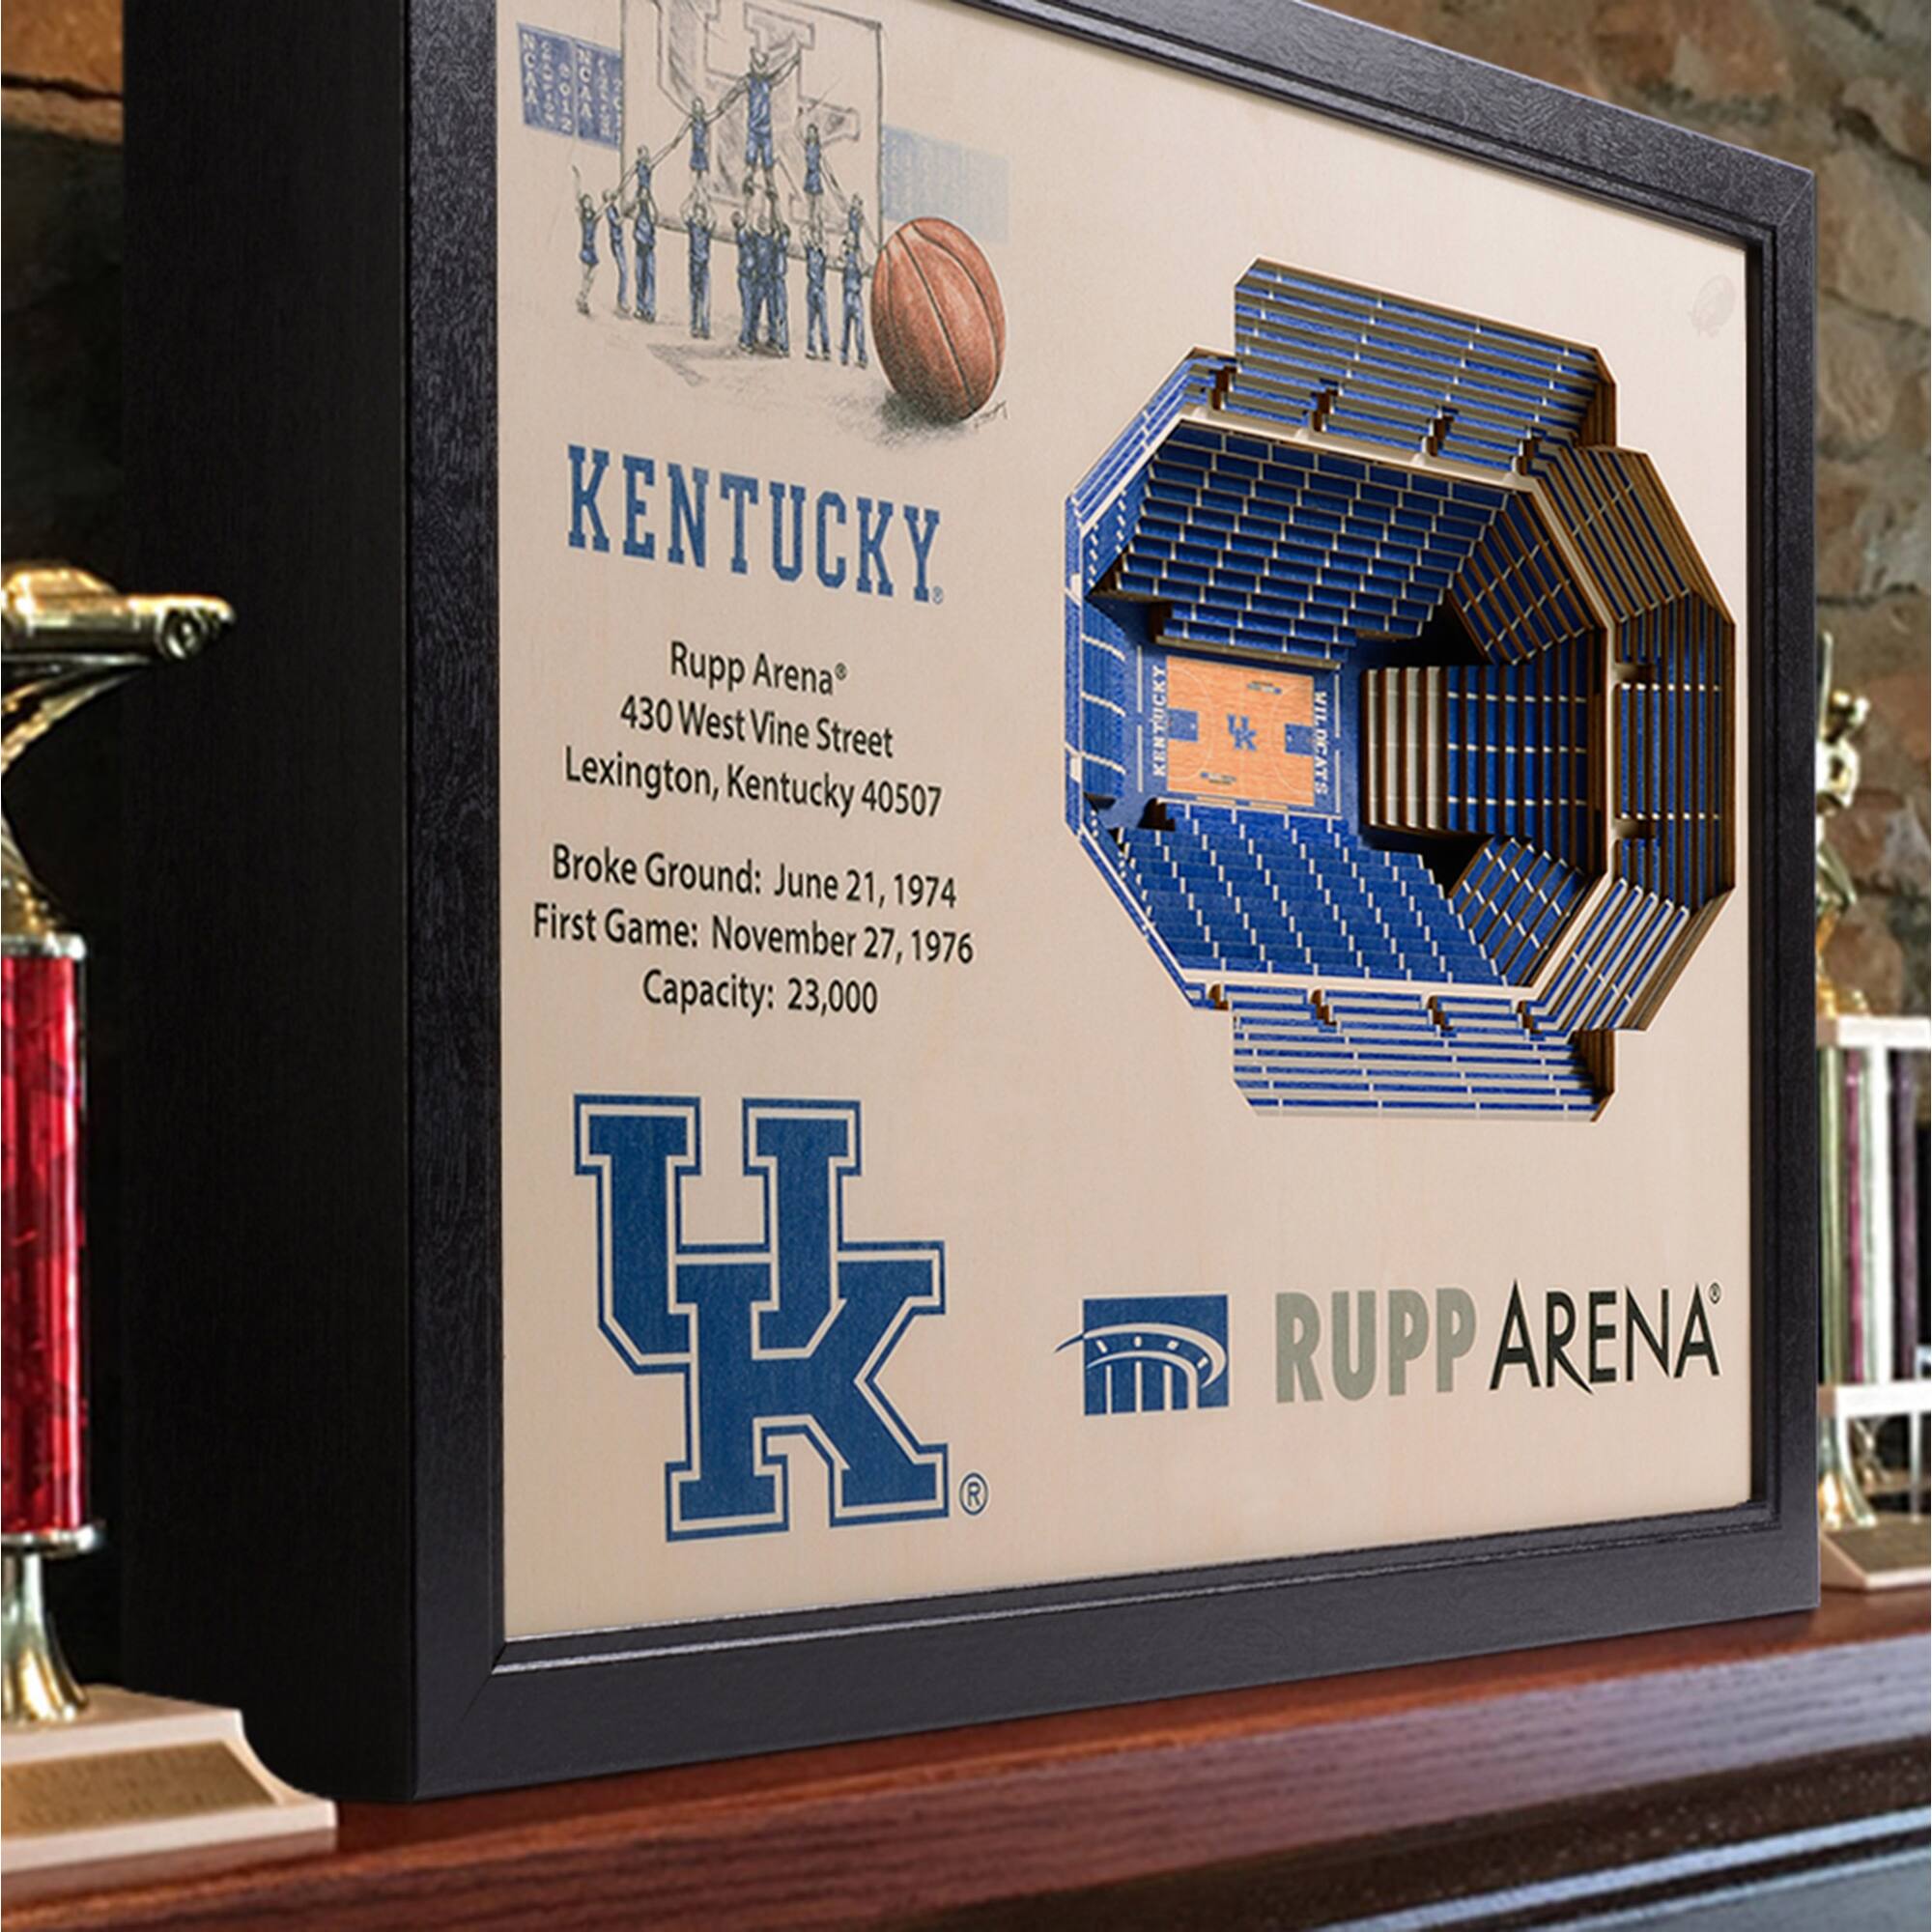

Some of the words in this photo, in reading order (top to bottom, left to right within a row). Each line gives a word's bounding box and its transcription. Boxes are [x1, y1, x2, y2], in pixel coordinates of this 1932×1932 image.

[671, 640, 745, 692] Rupp
[620, 695, 672, 733] 430
[678, 699, 745, 745] West
[750, 708, 810, 749] Vine
[816, 717, 893, 758] Street
[1314, 691, 1328, 796] WILDCATS
[566, 746, 719, 802] Lexington,
[727, 763, 855, 818] Kentucky
[861, 780, 942, 817] 40507
[554, 843, 637, 885] Broke
[645, 852, 760, 896] Ground:
[774, 863, 838, 900] June
[846, 869, 885, 908] 21,
[895, 873, 956, 908] 1974
[534, 902, 597, 943] First
[605, 907, 697, 948] Game:
[713, 915, 857, 957] November
[864, 925, 902, 964] 27,
[912, 929, 973, 964] 1976
[643, 969, 773, 1018] Capacity:
[788, 978, 877, 1016] 23,000
[1276, 1289, 1475, 1403] RUPP
